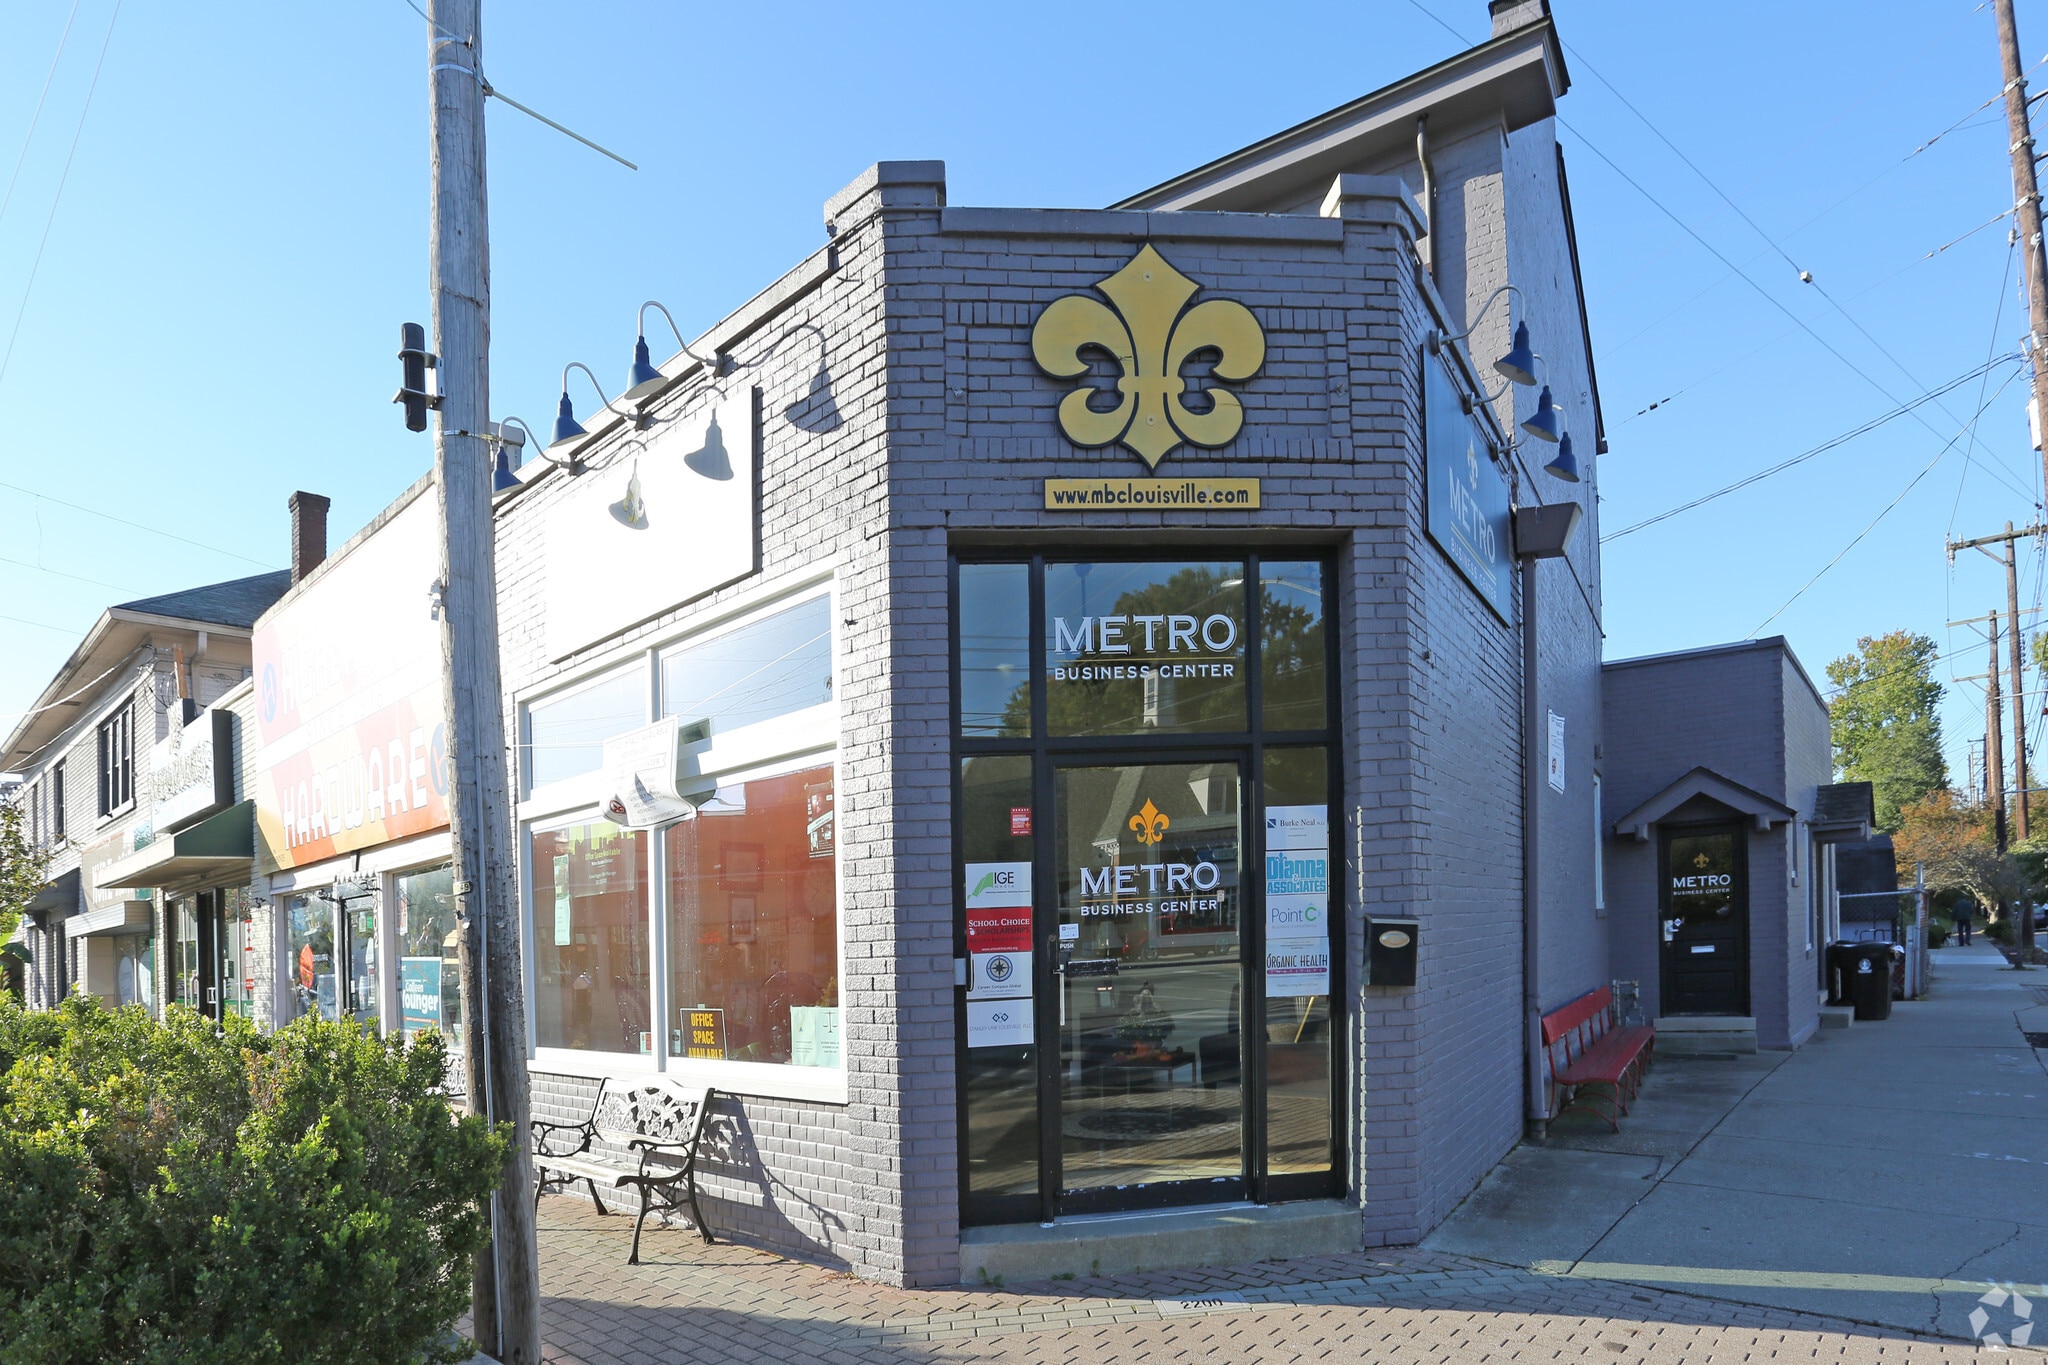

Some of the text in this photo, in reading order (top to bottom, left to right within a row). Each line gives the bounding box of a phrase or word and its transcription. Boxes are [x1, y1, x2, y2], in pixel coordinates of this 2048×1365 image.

[1053, 483, 1249, 504] www.mbclouisville.com
[1449, 466, 1495, 567] METRO
[1450, 537, 1496, 602] BUSINESS CENTER
[1054, 613, 1237, 655] METRO
[1054, 664, 1235, 681] BUSINESS CENTER
[283, 725, 428, 850] HARDWARE
[1280, 819, 1299, 827] Burke
[1266, 854, 1326, 879] Dianna
[994, 871, 1014, 884] IGE
[1080, 861, 1220, 896] METRO
[1673, 874, 1731, 888] METRO
[1267, 880, 1326, 894] ASSOCIATES
[1081, 899, 1217, 916] BUSINESS CENTER
[968, 918, 1031, 927] SCHOOL CHOICE
[1300, 954, 1328, 967] HEALTH
[405, 981, 424, 993] Colleen
[690, 1013, 714, 1027] OFFICE
[692, 1030, 715, 1045] SPACE
[688, 1047, 723, 1060] AVAILABLE
[1181, 1298, 1224, 1309] 2200
